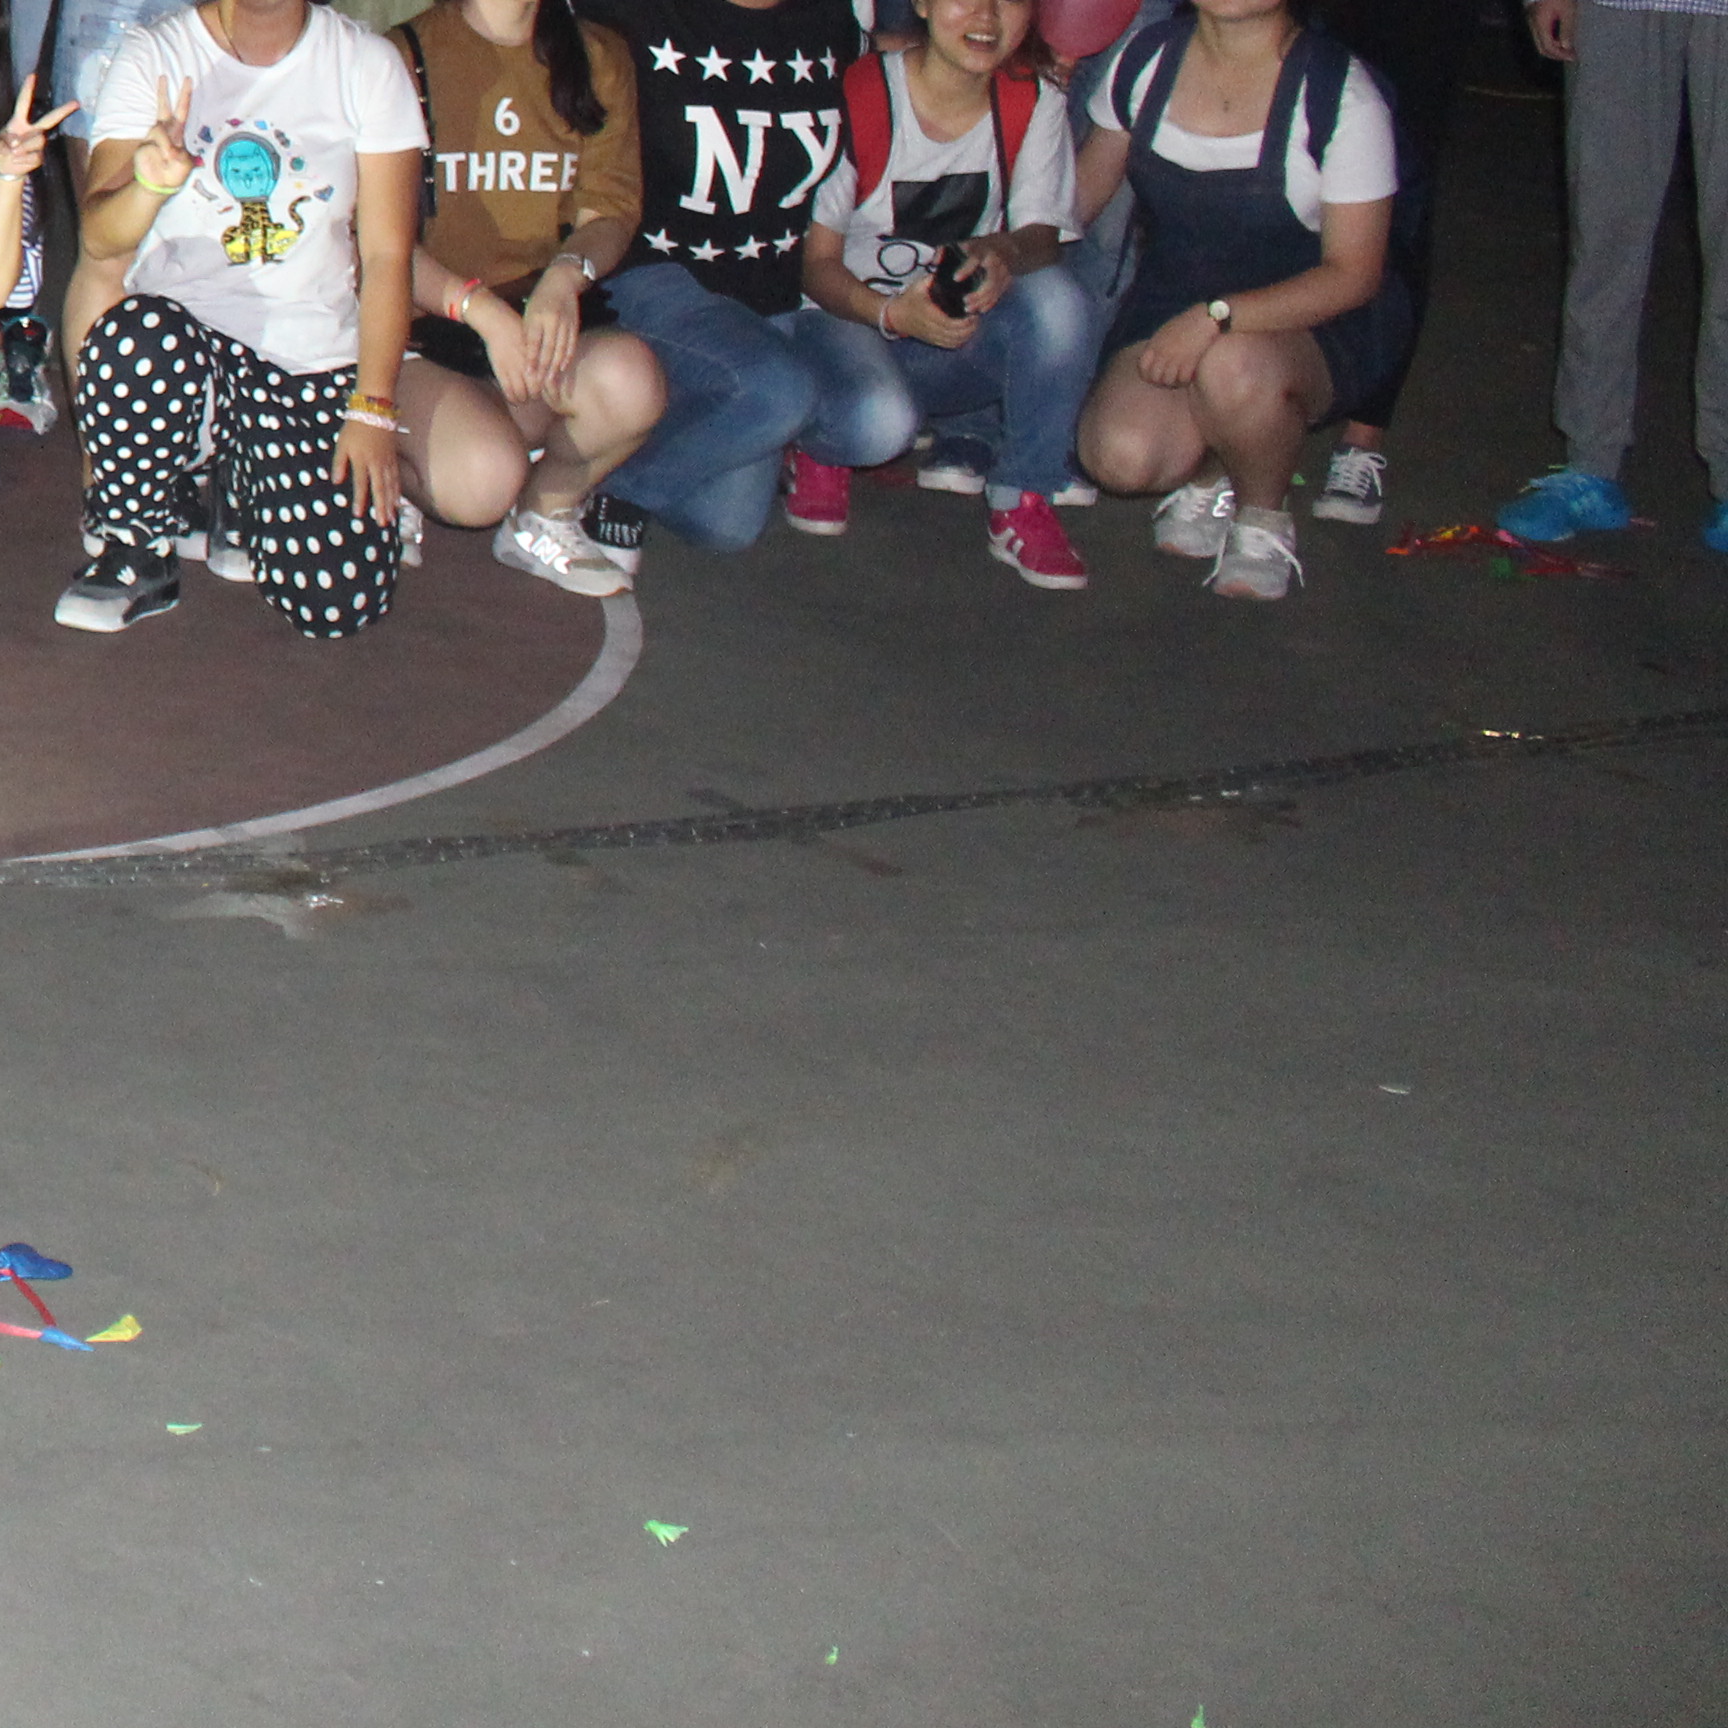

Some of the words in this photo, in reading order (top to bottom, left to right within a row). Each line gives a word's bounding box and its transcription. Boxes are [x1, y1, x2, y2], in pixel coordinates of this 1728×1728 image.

[493, 95, 522, 137] 6
[435, 150, 580, 193] THREE
[678, 103, 843, 216] NY
